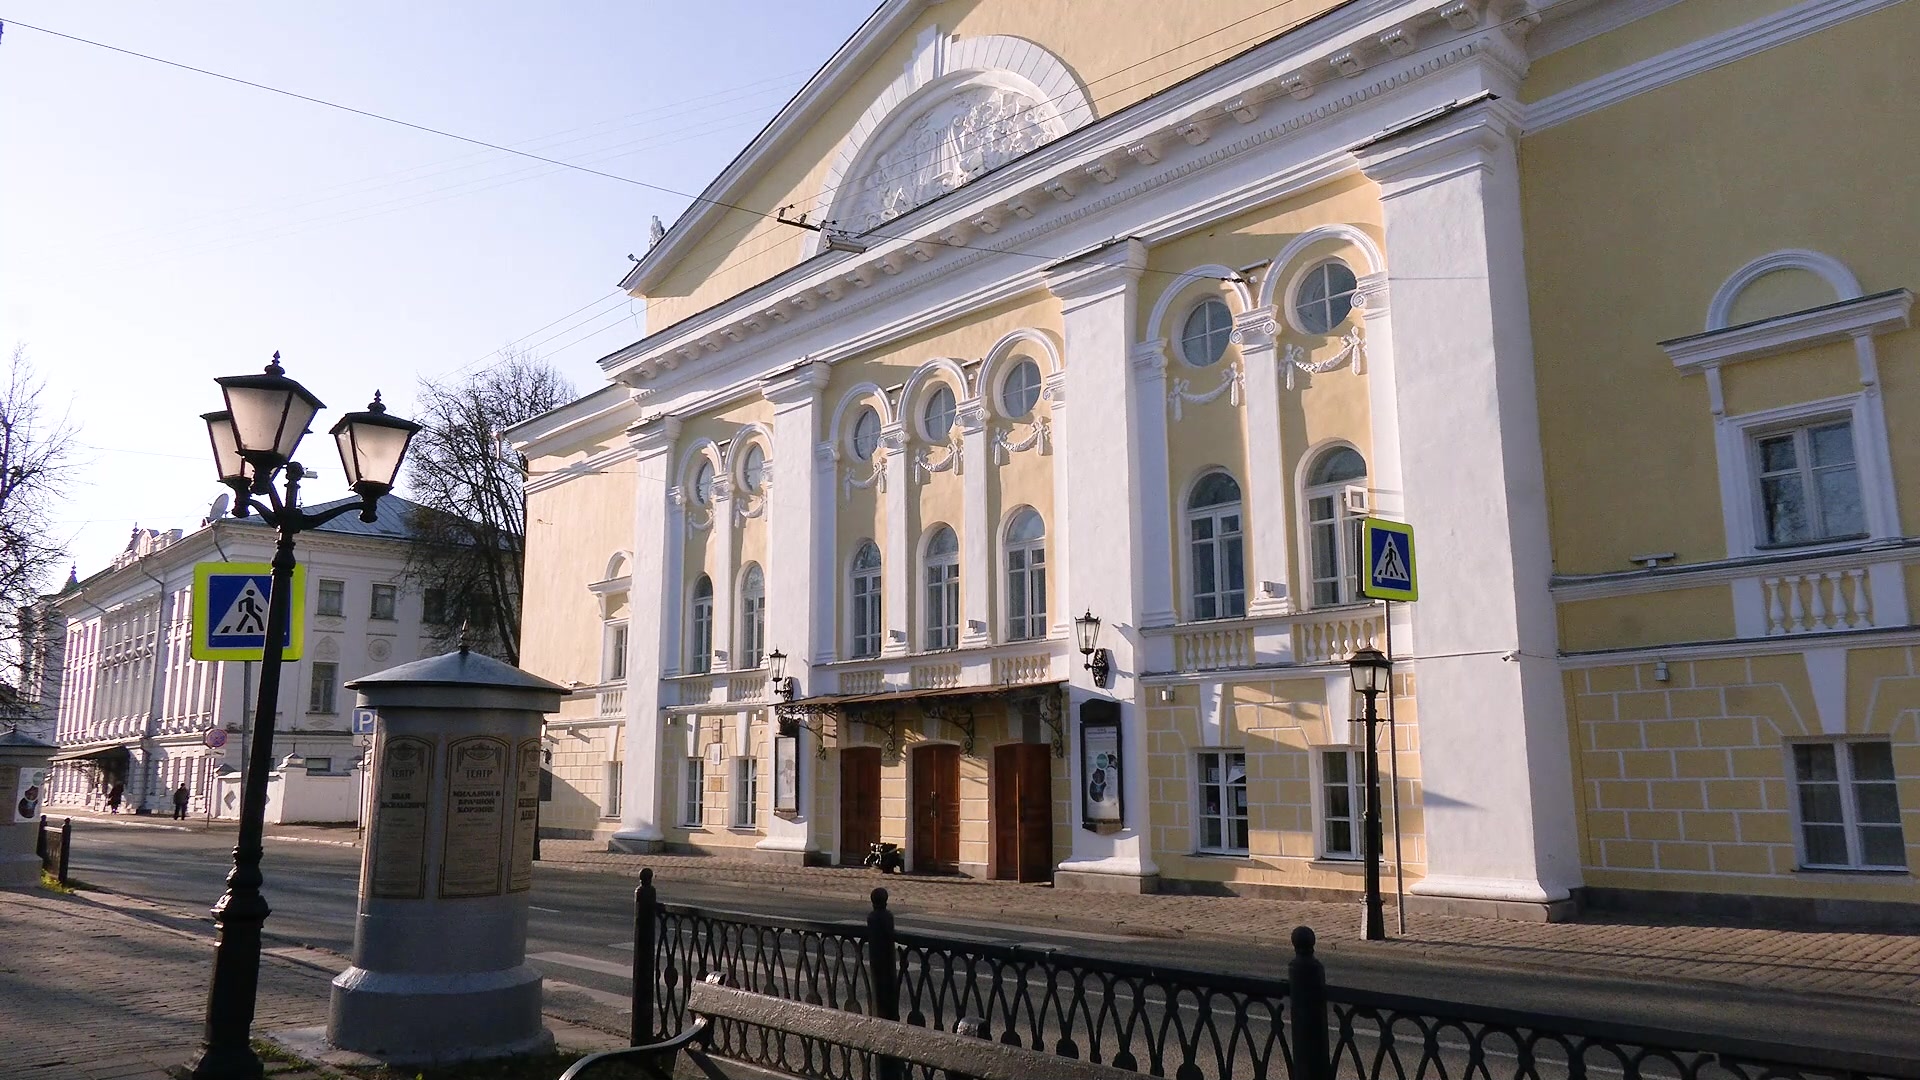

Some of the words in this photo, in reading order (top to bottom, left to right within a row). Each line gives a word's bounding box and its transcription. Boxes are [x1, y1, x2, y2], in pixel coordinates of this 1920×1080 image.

[359, 711, 374, 731] P
[391, 769, 415, 778] ТЕАТР
[466, 769, 493, 778] ТЕАТР
